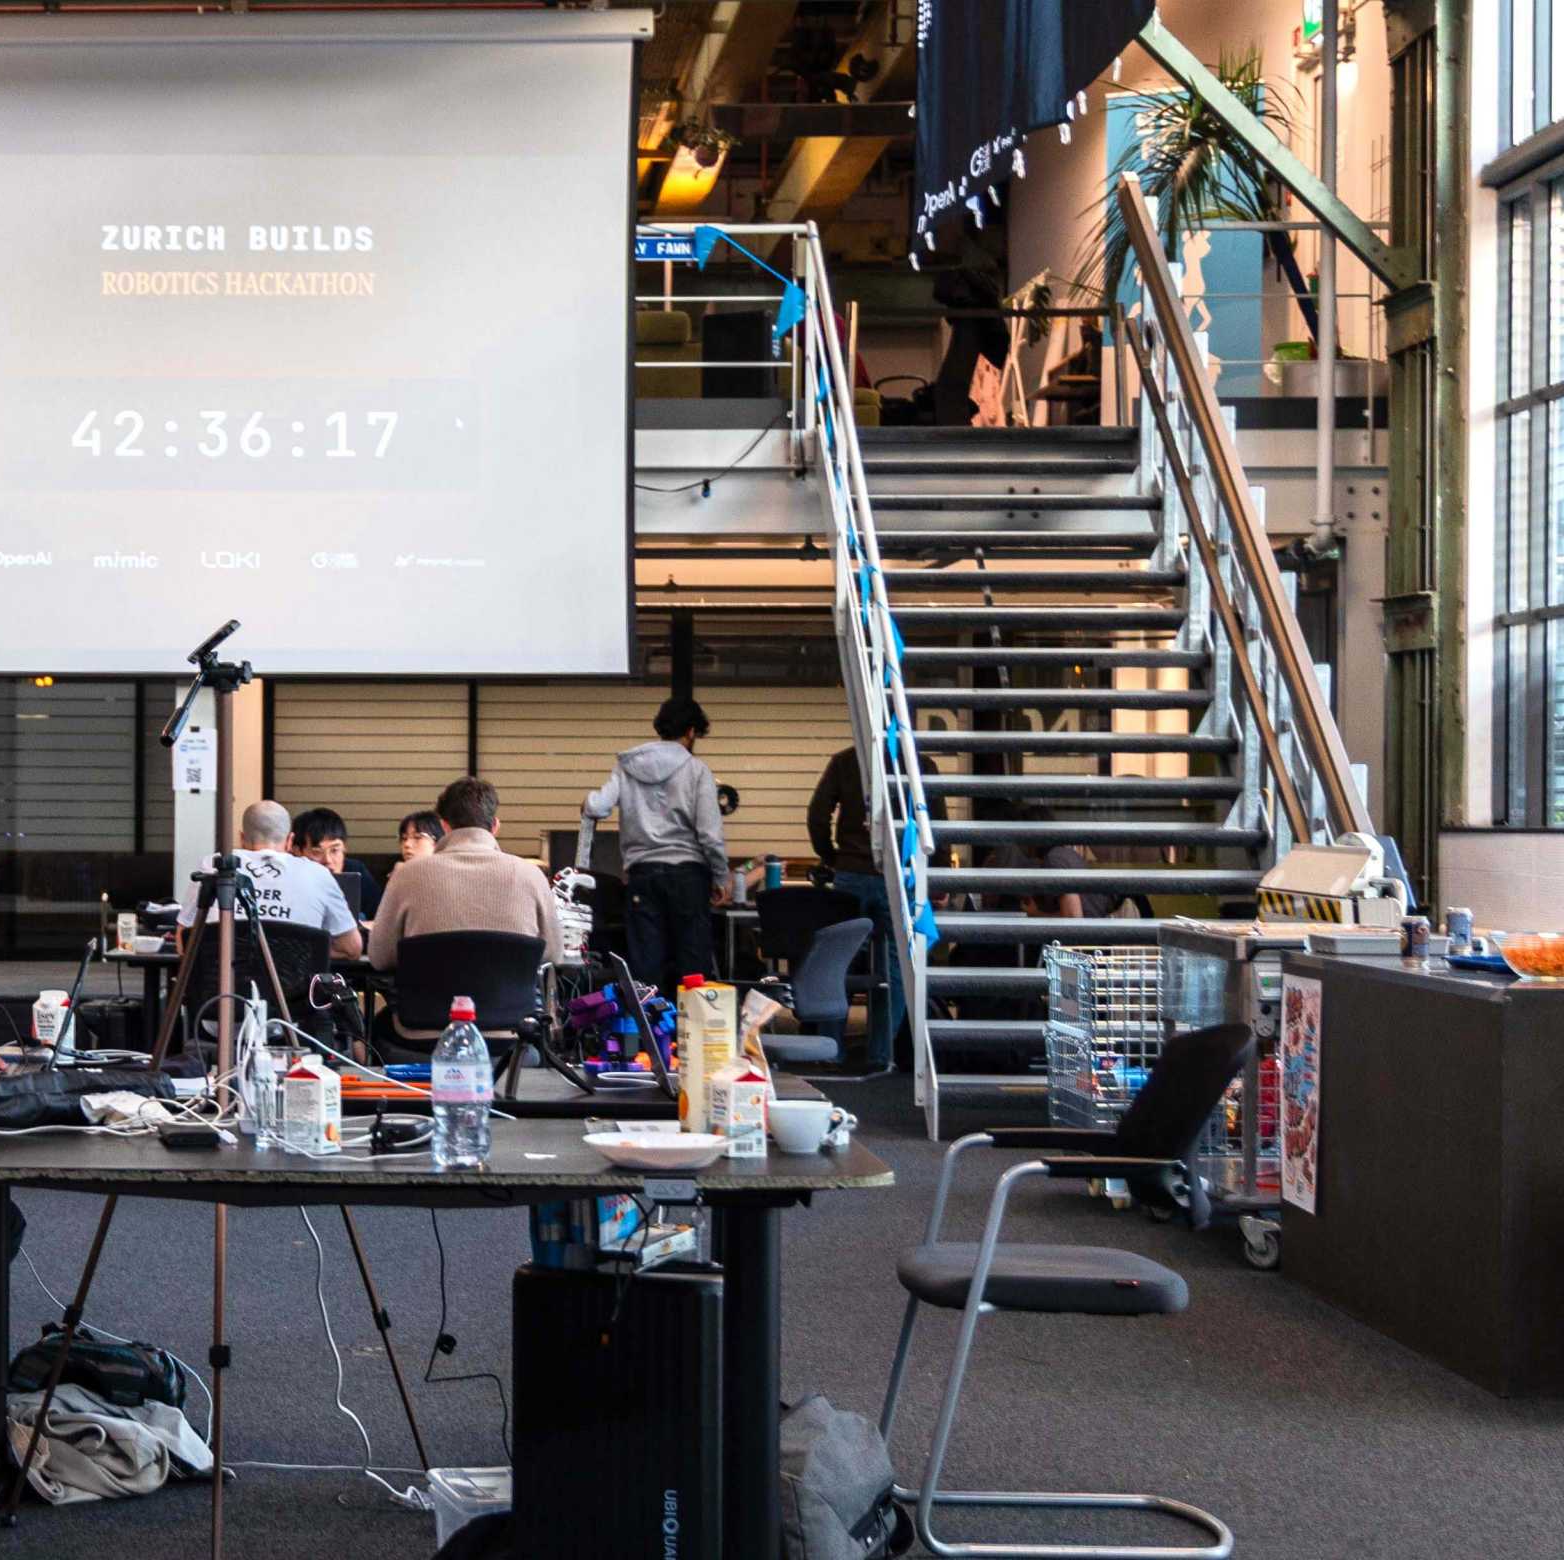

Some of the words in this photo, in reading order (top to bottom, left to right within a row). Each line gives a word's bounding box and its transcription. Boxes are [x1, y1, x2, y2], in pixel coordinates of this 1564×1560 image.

[101, 225, 226, 251] ZURICH
[248, 225, 374, 251] BUILDS
[101, 271, 220, 296] ROBOTICS
[224, 271, 375, 296] HACKATHON
[71, 409, 399, 459] 42:36:17
[93, 550, 160, 569] mimic
[201, 551, 261, 569] LOKI
[236, 904, 291, 919] ESCH
